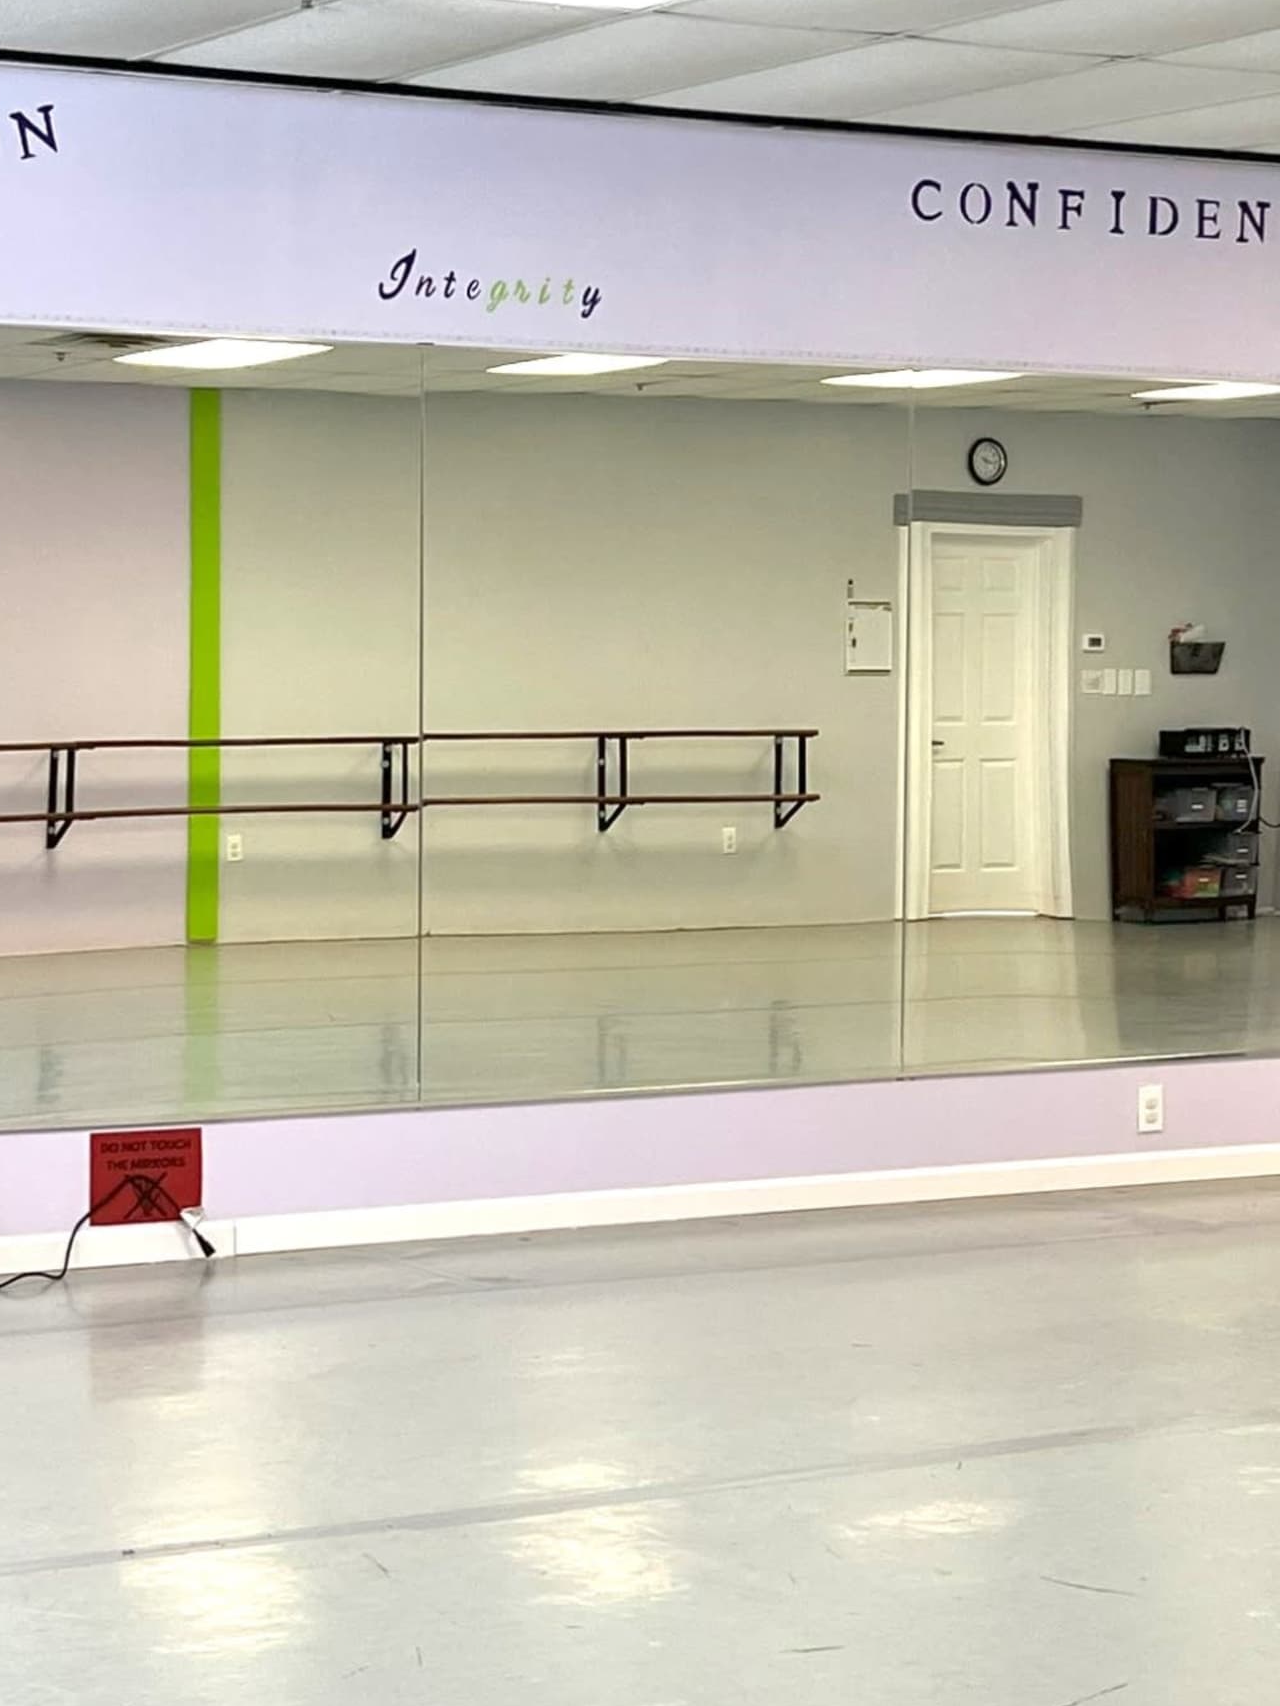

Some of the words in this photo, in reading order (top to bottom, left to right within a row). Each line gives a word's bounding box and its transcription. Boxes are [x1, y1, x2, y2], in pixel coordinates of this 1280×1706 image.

[378, 248, 602, 319] Integrity
[100, 1141, 119, 1153] DO
[121, 1140, 147, 1152] NOT
[151, 1138, 191, 1150] TOUCH
[107, 1159, 129, 1171] THE
[130, 1156, 186, 1170] MIRRORS
